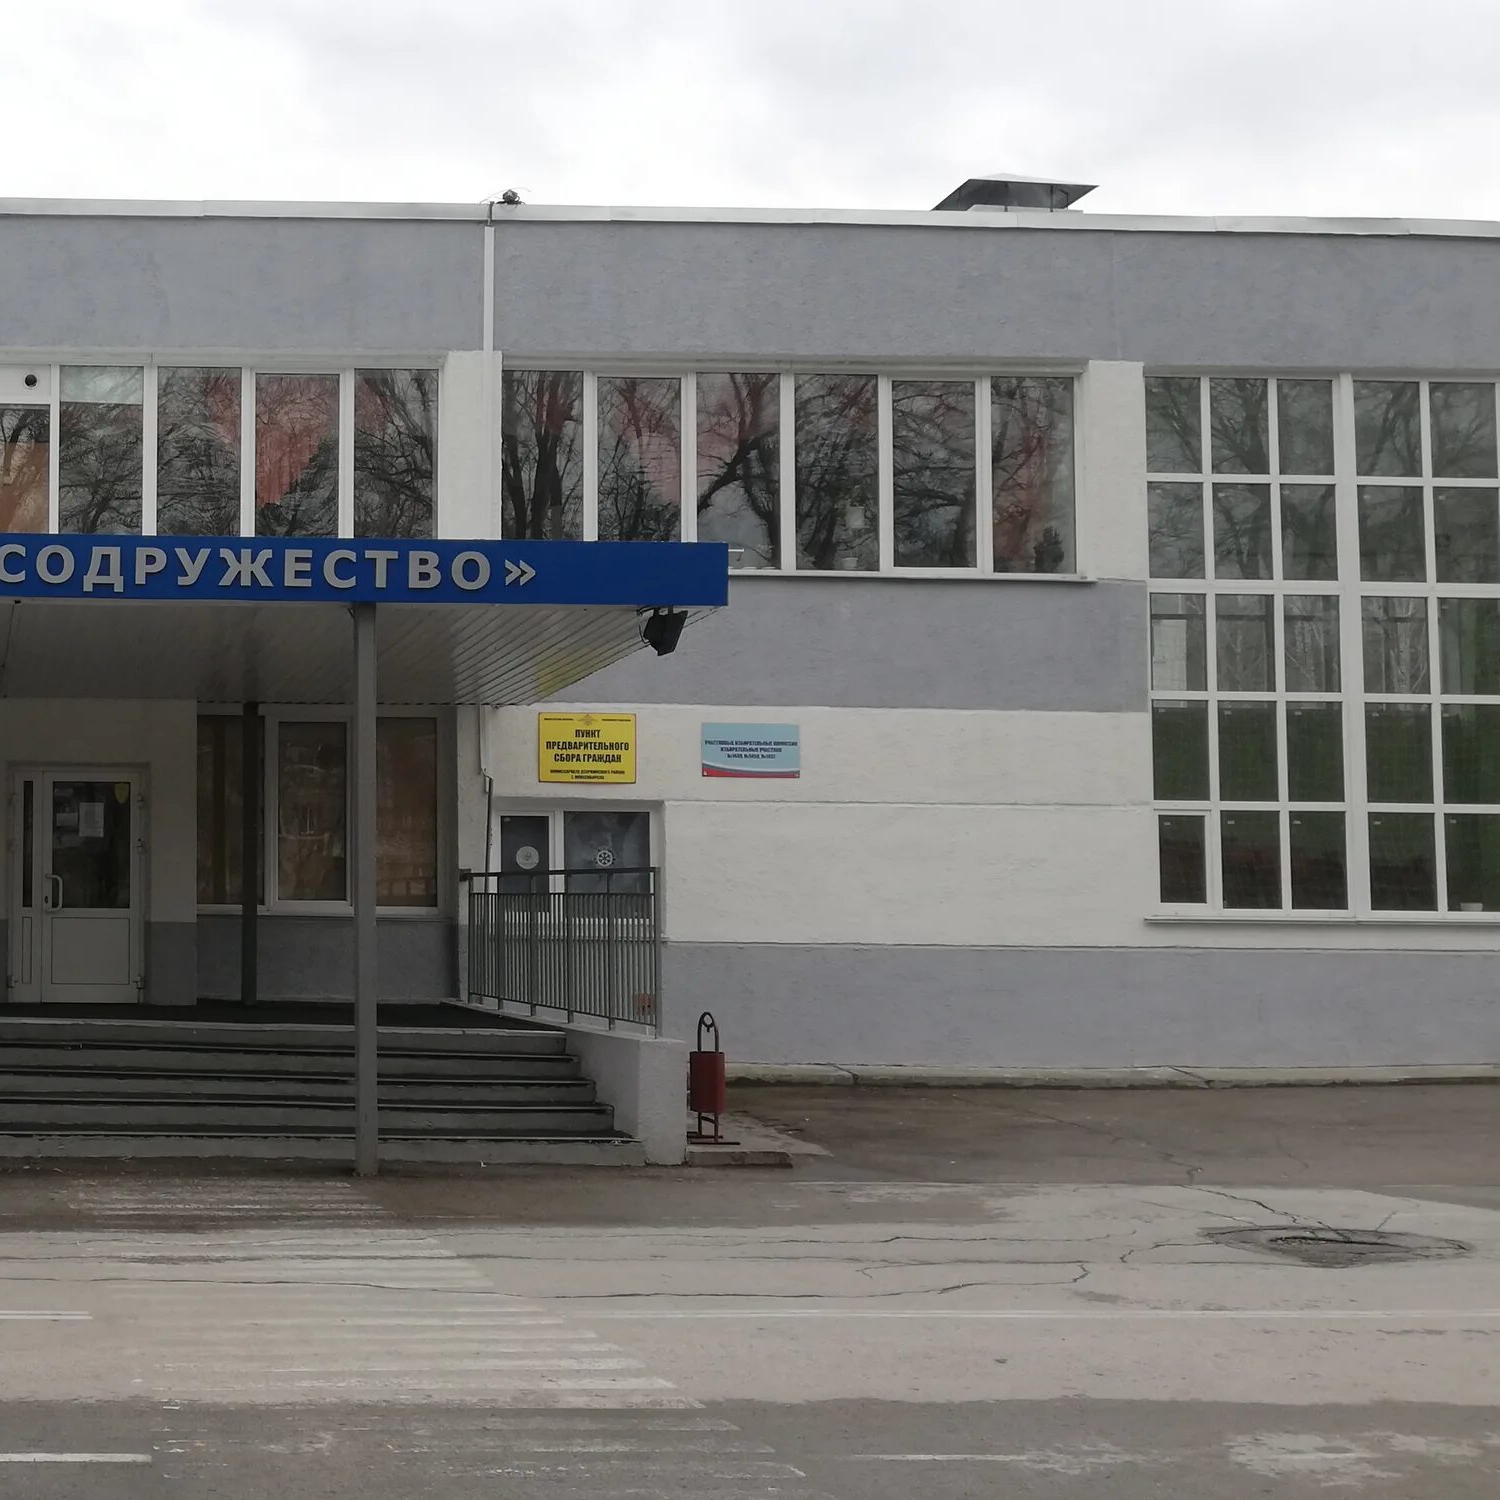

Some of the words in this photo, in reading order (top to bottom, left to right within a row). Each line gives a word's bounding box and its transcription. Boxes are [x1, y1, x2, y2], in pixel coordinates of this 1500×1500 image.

[575, 729, 601, 738] ПУНКТ
[546, 741, 630, 751] ПРЕДВАРИТЕЛЬНОГО
[554, 753, 581, 763] СБОРА
[583, 753, 622, 764] ГРАЖДАН
